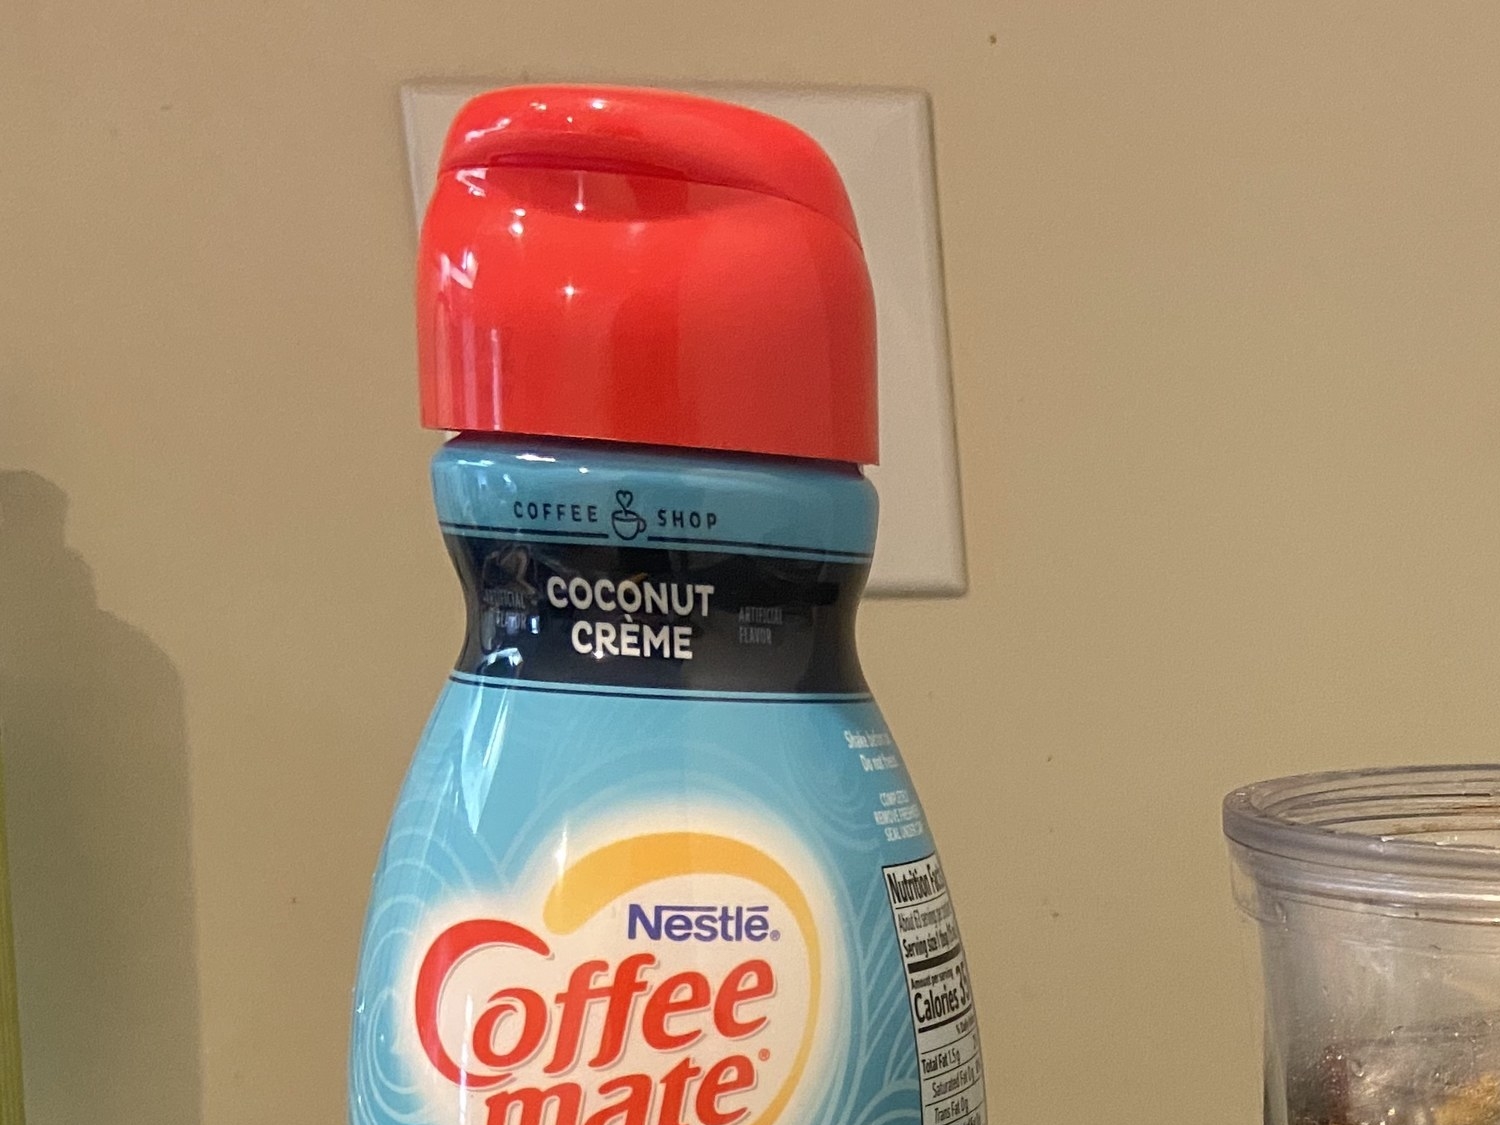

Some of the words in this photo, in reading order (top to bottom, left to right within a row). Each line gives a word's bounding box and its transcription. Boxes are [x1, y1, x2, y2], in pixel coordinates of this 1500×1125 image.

[513, 501, 598, 522] COFFEE
[657, 509, 717, 530] SHOP
[547, 575, 715, 617] COCONUT
[571, 614, 693, 659] CRÈME
[887, 868, 932, 904] Nutrition
[415, 918, 776, 1090] Coffee
[914, 984, 960, 1023] Calories
[921, 1054, 938, 1074] Total
[938, 1052, 949, 1069] Fat
[932, 1071, 959, 1098] Saturated
[959, 1070, 968, 1085] Fat
[934, 1106, 951, 1124] Trans
[951, 1101, 960, 1117] Fat
